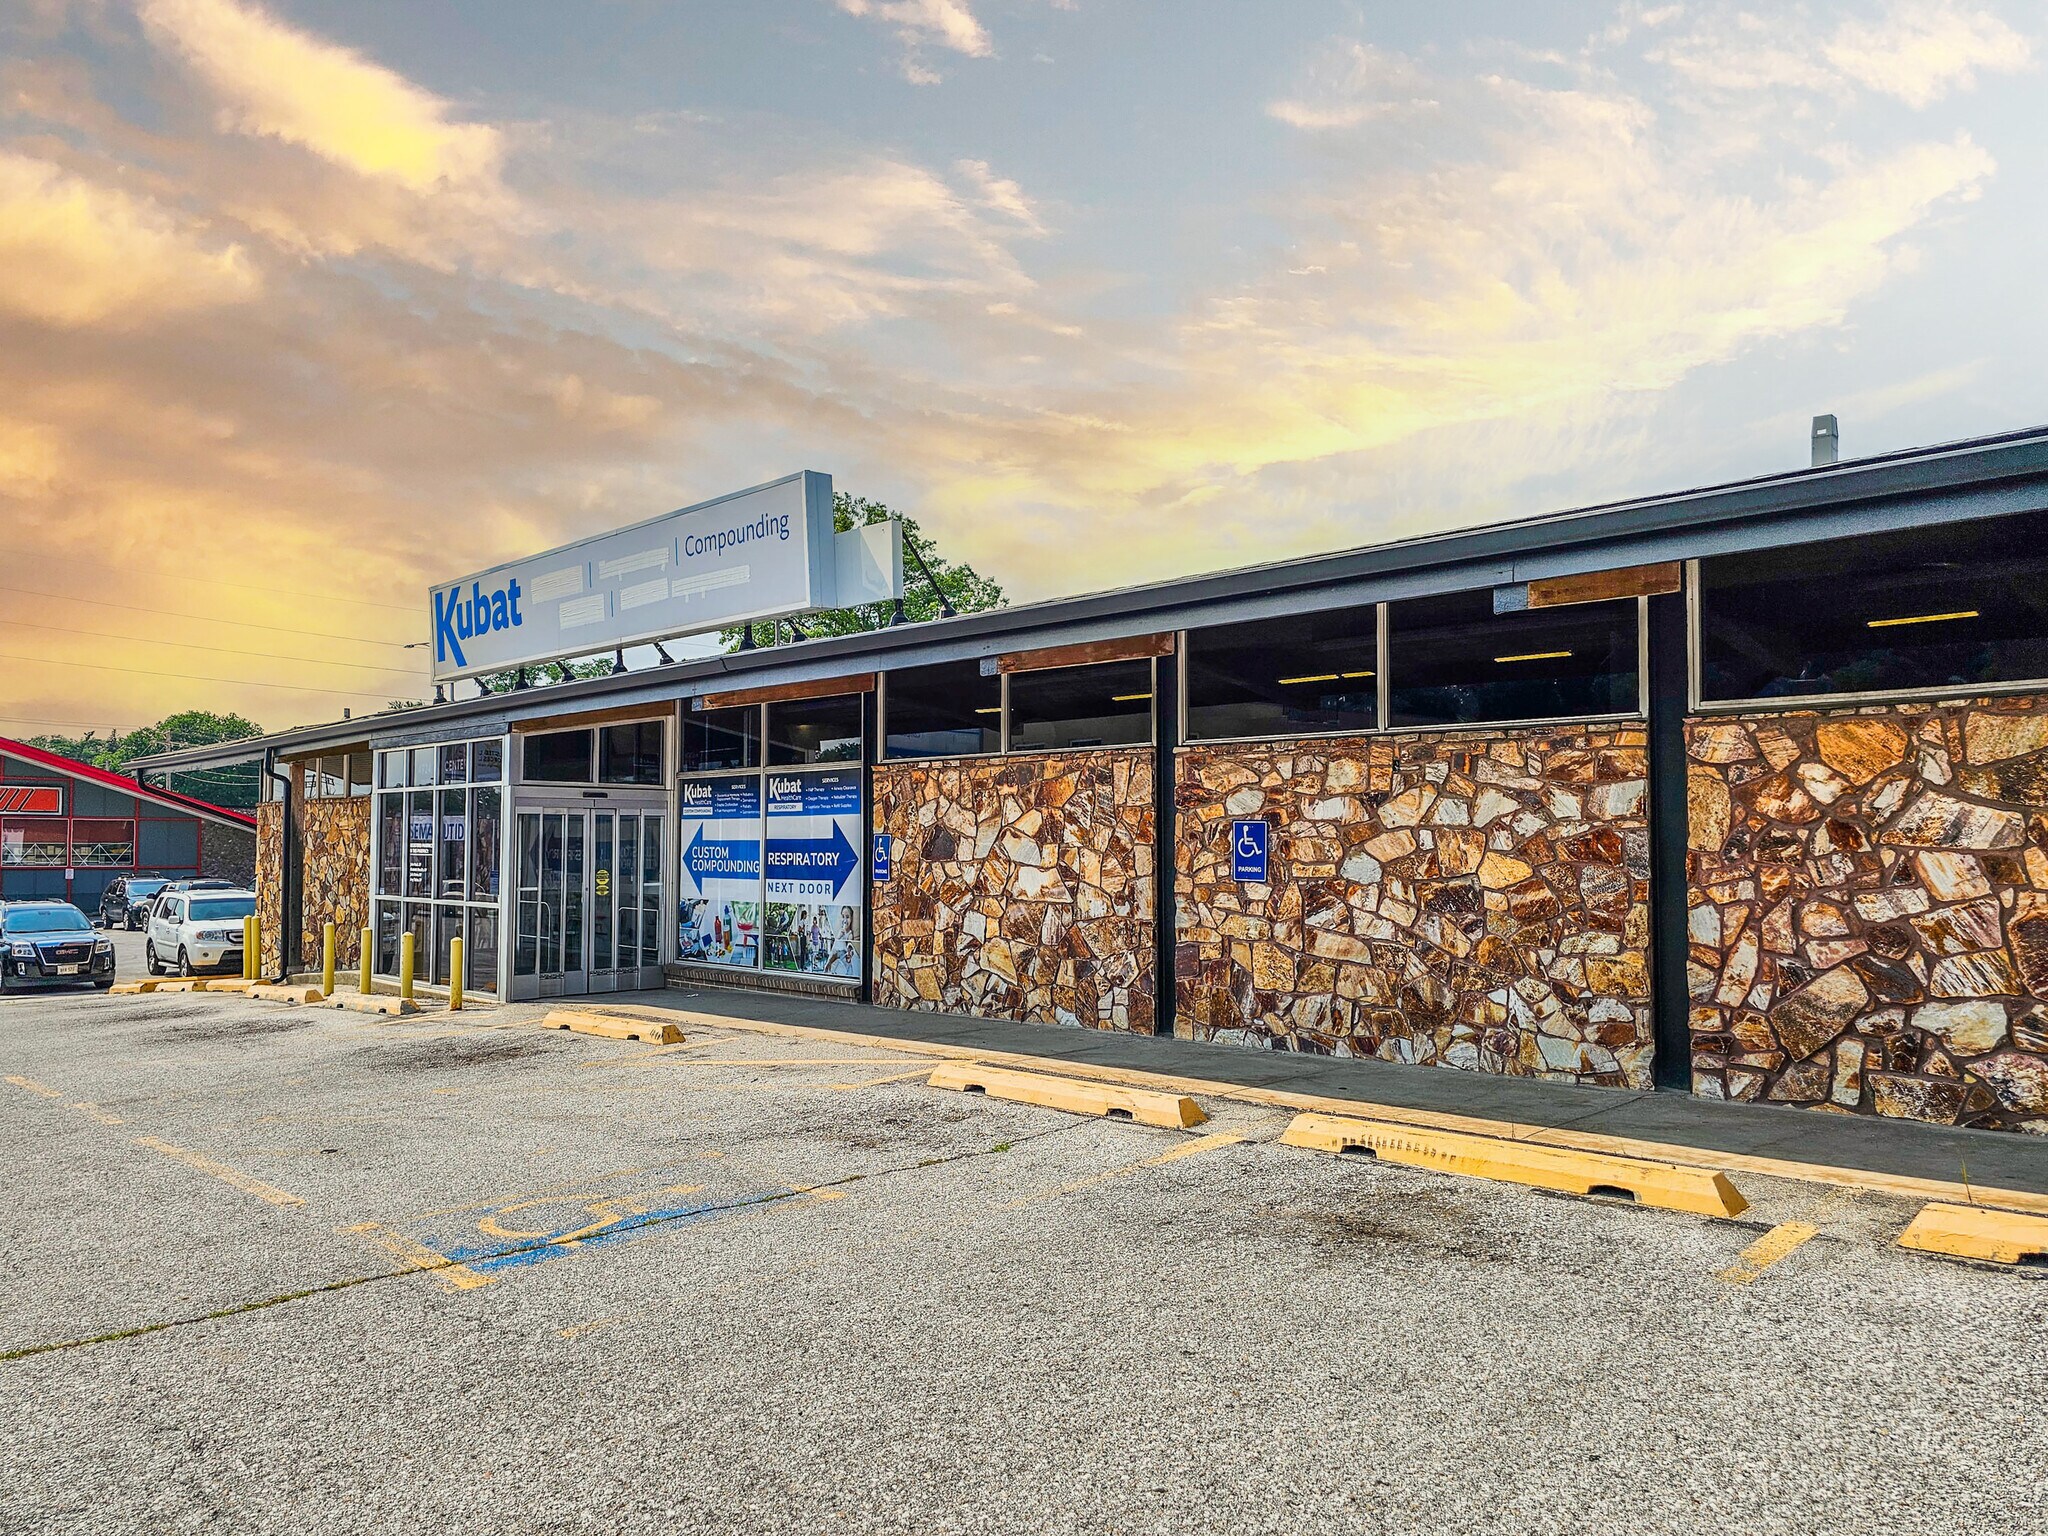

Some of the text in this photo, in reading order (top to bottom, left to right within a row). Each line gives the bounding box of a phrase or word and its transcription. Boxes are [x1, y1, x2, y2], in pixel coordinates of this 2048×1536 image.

[684, 513, 790, 557] Compounding
[434, 577, 523, 668] Kubat
[445, 759, 464, 772] CENTE
[684, 783, 712, 805] Kubat
[769, 777, 802, 801] Kubat
[691, 846, 729, 859] CUSTOM
[768, 852, 840, 866] RESPIRATORY
[691, 859, 760, 873] COMPOUNDING
[768, 882, 831, 895] NEXT DOOR
